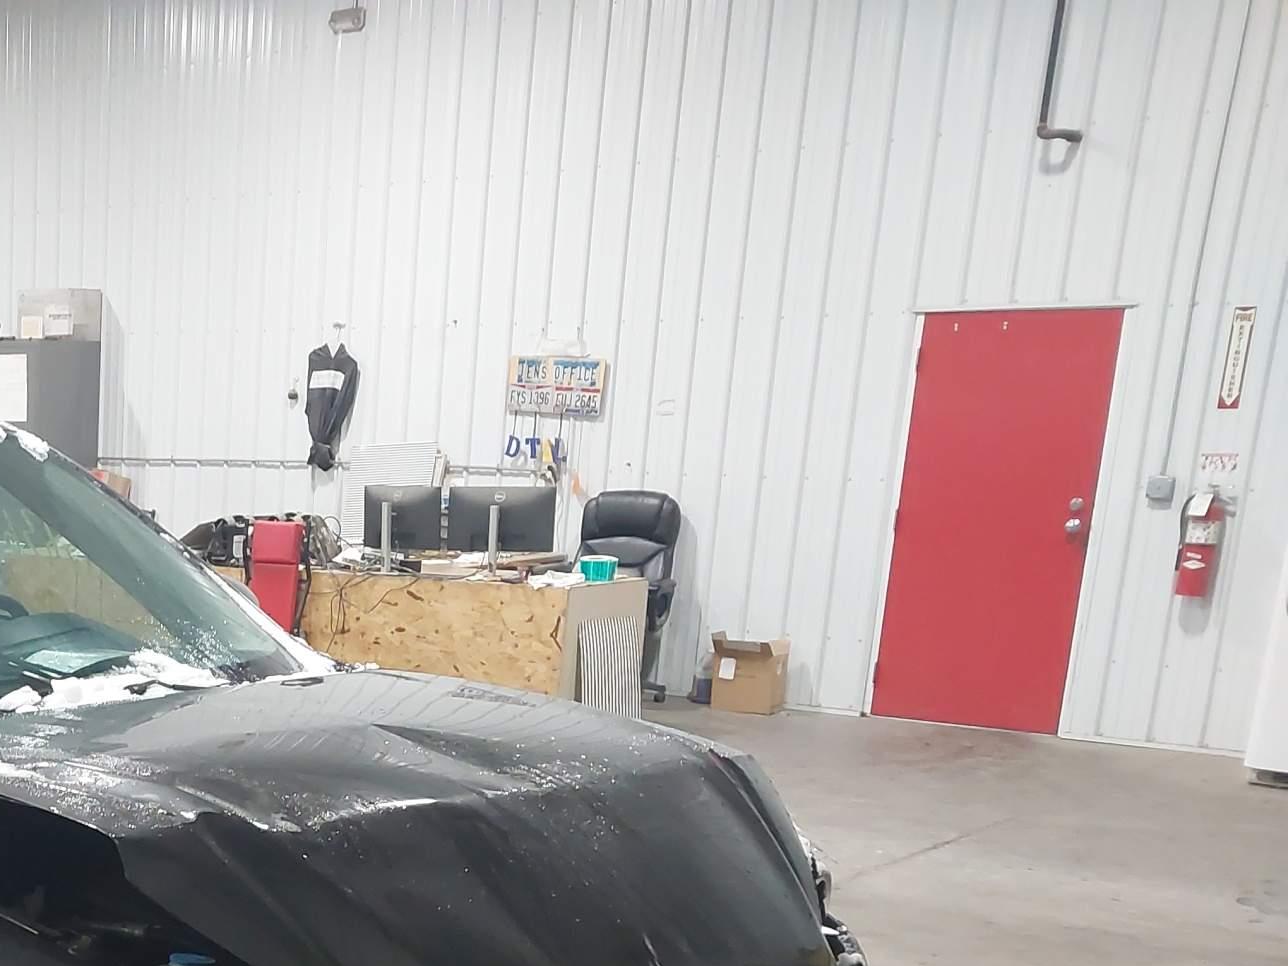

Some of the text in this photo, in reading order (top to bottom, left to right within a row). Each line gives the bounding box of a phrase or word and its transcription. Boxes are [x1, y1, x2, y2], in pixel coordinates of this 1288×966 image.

[1235, 312, 1253, 322] FIRE
[519, 363, 596, 381] JENS OFFICE
